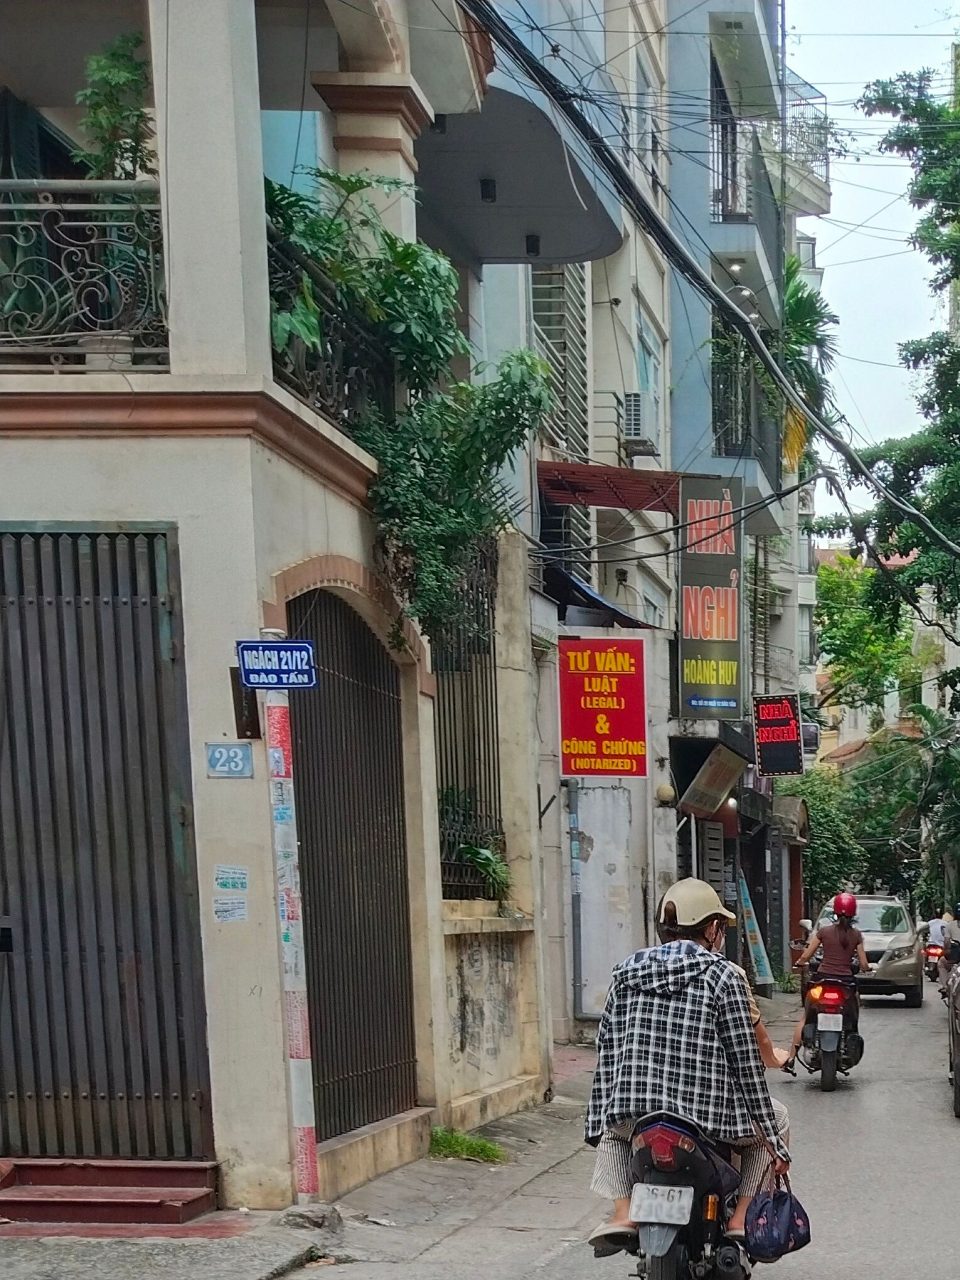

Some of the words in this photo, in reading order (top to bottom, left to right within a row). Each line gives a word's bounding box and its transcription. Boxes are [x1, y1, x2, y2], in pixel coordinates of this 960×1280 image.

[686, 488, 736, 555] NHÀ
[682, 568, 738, 641] NGHỈ
[243, 646, 279, 670] NGÁCH
[280, 649, 310, 670] 21/12
[566, 649, 591, 672] TƯ
[594, 646, 636, 672] VẤN:
[249, 671, 277, 684] ĐÀO
[280, 671, 309, 684] TẤN
[683, 655, 717, 685] HOÀNG
[718, 660, 738, 686] HUY
[583, 674, 619, 695] LUẬT
[759, 699, 794, 720] NHÀ
[595, 713, 610, 735] &
[758, 719, 798, 743] NGHỈ
[562, 737, 597, 755] CÔNG
[601, 737, 646, 756] CHỨNG
[214, 748, 244, 772] 23
